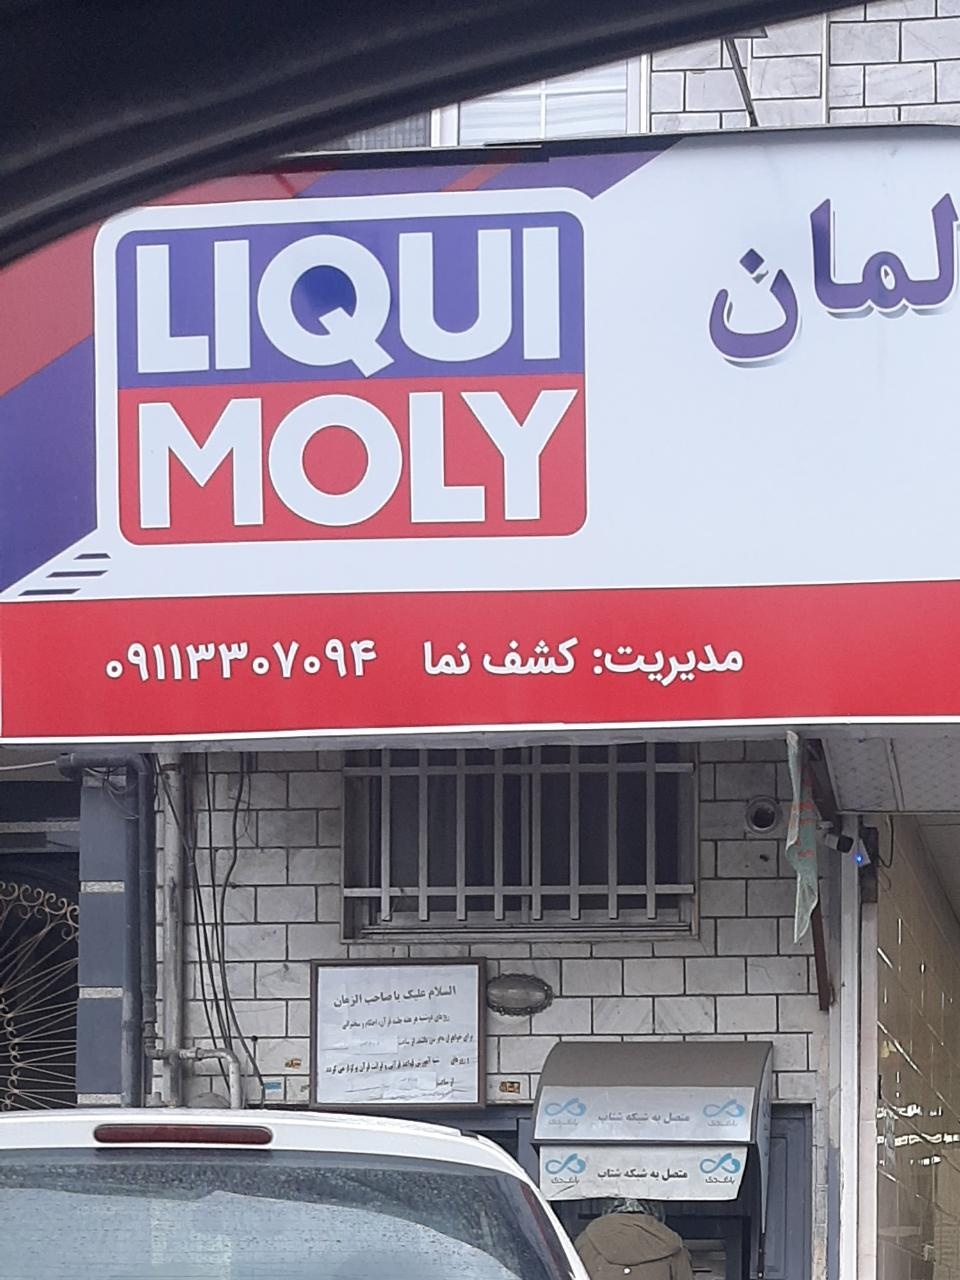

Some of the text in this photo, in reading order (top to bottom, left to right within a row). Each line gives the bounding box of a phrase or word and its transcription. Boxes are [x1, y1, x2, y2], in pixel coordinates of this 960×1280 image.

[136, 225, 562, 378] LIQUI
[138, 388, 578, 531] MOLY
[105, 637, 377, 682] ۰۹۱۱۳۳۰۷۰۹۴
[423, 637, 744, 688] مدیریت: کشف نما
[364, 991, 392, 1006] صاحب
[428, 985, 456, 999] السلام
[598, 1112, 690, 1124] متصل به شبکه شتاب
[597, 1168, 688, 1180] متصل به شبکه شتاب
